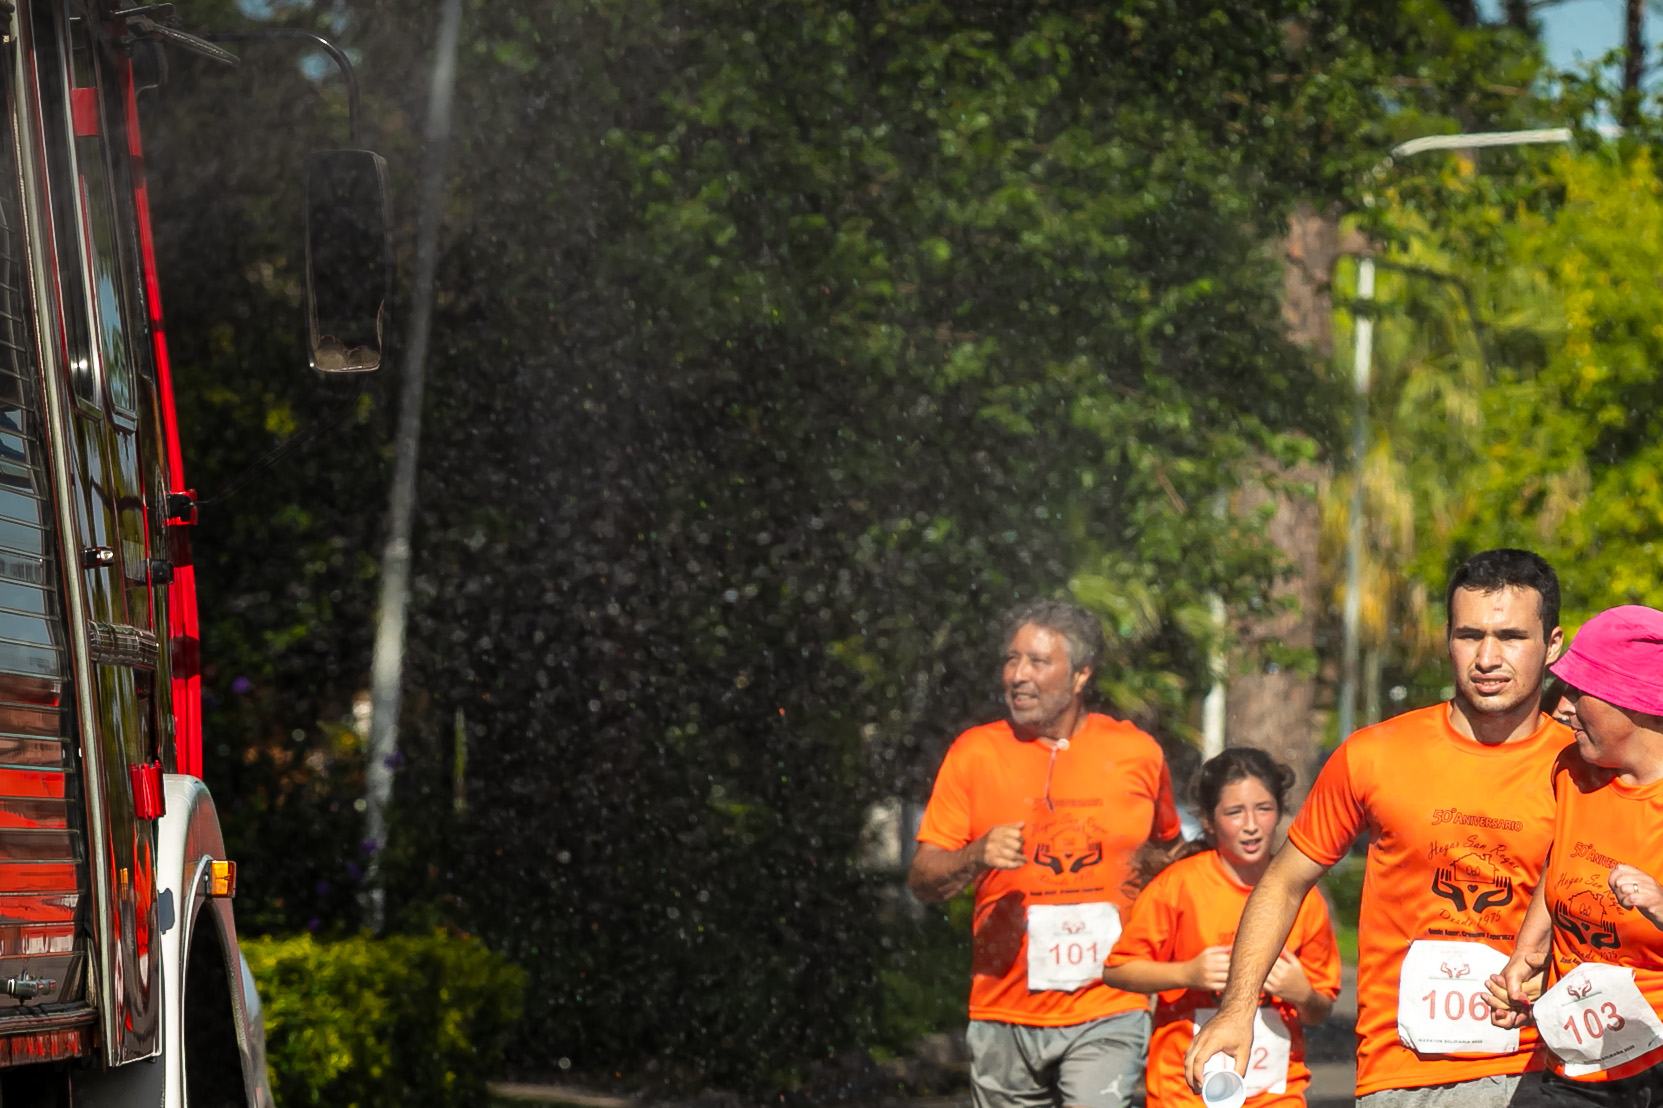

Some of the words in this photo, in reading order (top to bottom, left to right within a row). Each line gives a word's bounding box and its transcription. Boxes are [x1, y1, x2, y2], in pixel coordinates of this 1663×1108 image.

[1453, 812, 1523, 832] ANIVERSARIO
[1428, 840, 1460, 860] Hogar
[1463, 834, 1487, 850] San
[1490, 844, 1519, 869] Roque
[1554, 872, 1583, 890] Hogar
[1585, 873, 1604, 889] San
[1439, 908, 1473, 927] Desde
[1478, 909, 1501, 927] 1975
[1049, 942, 1097, 966] 101
[1422, 989, 1491, 1021] 106
[1563, 1002, 1625, 1045] 103
[1217, 1047, 1269, 1070] 12
